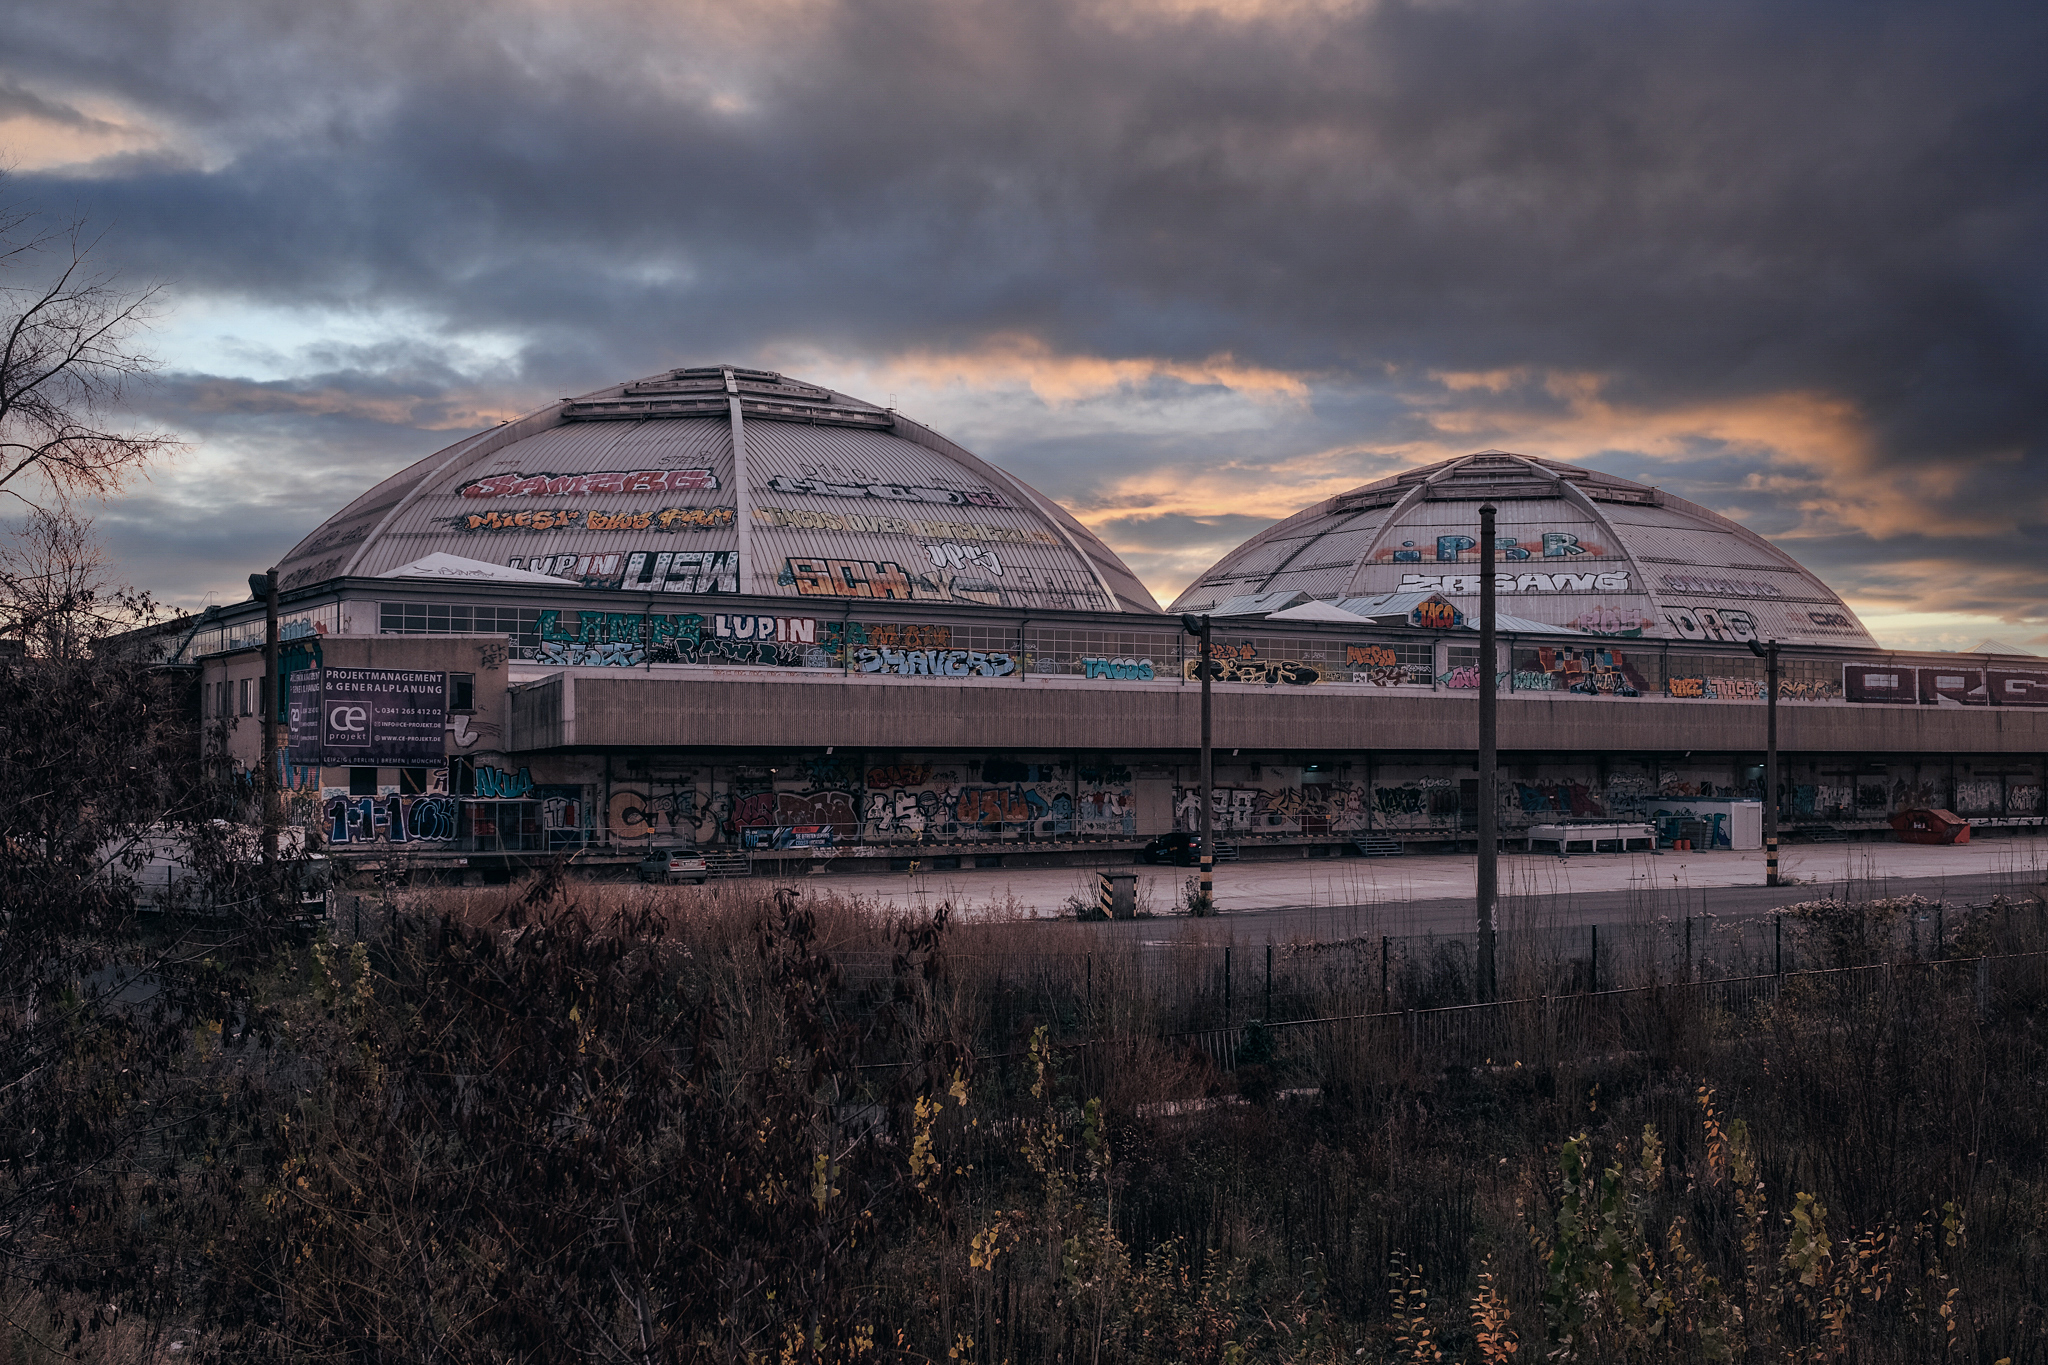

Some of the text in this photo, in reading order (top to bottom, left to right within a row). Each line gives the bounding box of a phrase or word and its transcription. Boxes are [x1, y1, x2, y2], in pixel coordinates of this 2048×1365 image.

[1418, 602, 1454, 628] TACO
[713, 613, 817, 644] LUPIN
[1083, 656, 1155, 681] TACOS
[326, 670, 443, 683] PROJEKTMANAGEMENT
[325, 682, 442, 694] & GENERALPLANUNG
[381, 707, 399, 715] 0341
[417, 708, 431, 716] 412
[432, 708, 442, 716] 02
[329, 732, 367, 742] projekt
[411, 757, 442, 765] MÜNCHEN
